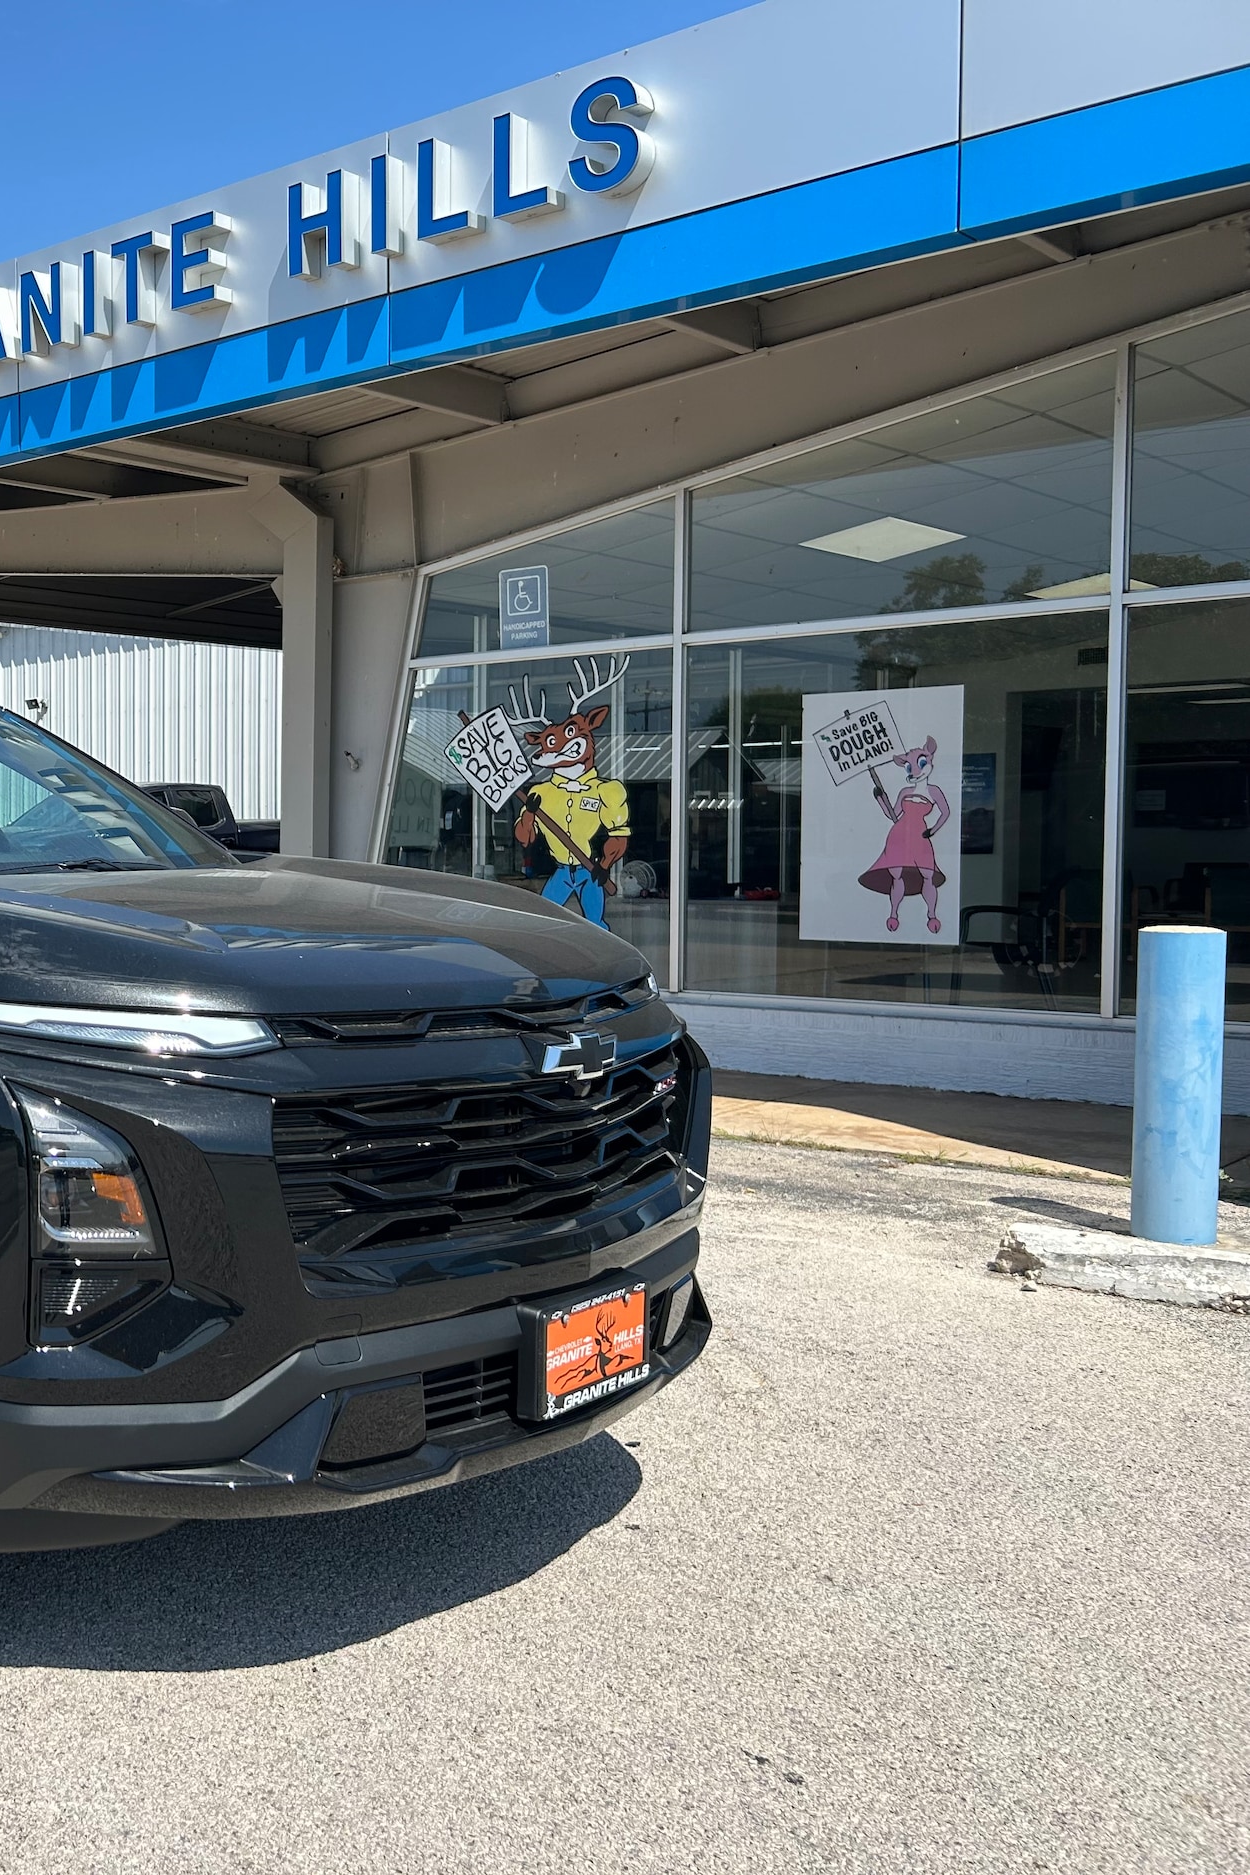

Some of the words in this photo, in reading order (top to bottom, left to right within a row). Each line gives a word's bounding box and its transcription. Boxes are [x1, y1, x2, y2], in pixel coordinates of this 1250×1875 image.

[287, 76, 655, 281] HILLS
[503, 620, 546, 632] HANDICAPPED
[511, 631, 538, 640] PARKING
[457, 712, 505, 758] SAVE
[832, 723, 859, 740] Save
[859, 711, 878, 727] BIG
[828, 721, 888, 762] DOUGH
[850, 738, 894, 766] LLANO!
[466, 737, 512, 783] BIG
[483, 755, 528, 803] BUCKS
[554, 1338, 584, 1355] CHEVROLET
[613, 1324, 644, 1345] HILLS
[546, 1343, 593, 1371] GRANITE
[563, 1378, 618, 1409] GRANITE
[618, 1363, 650, 1388] HILLS
